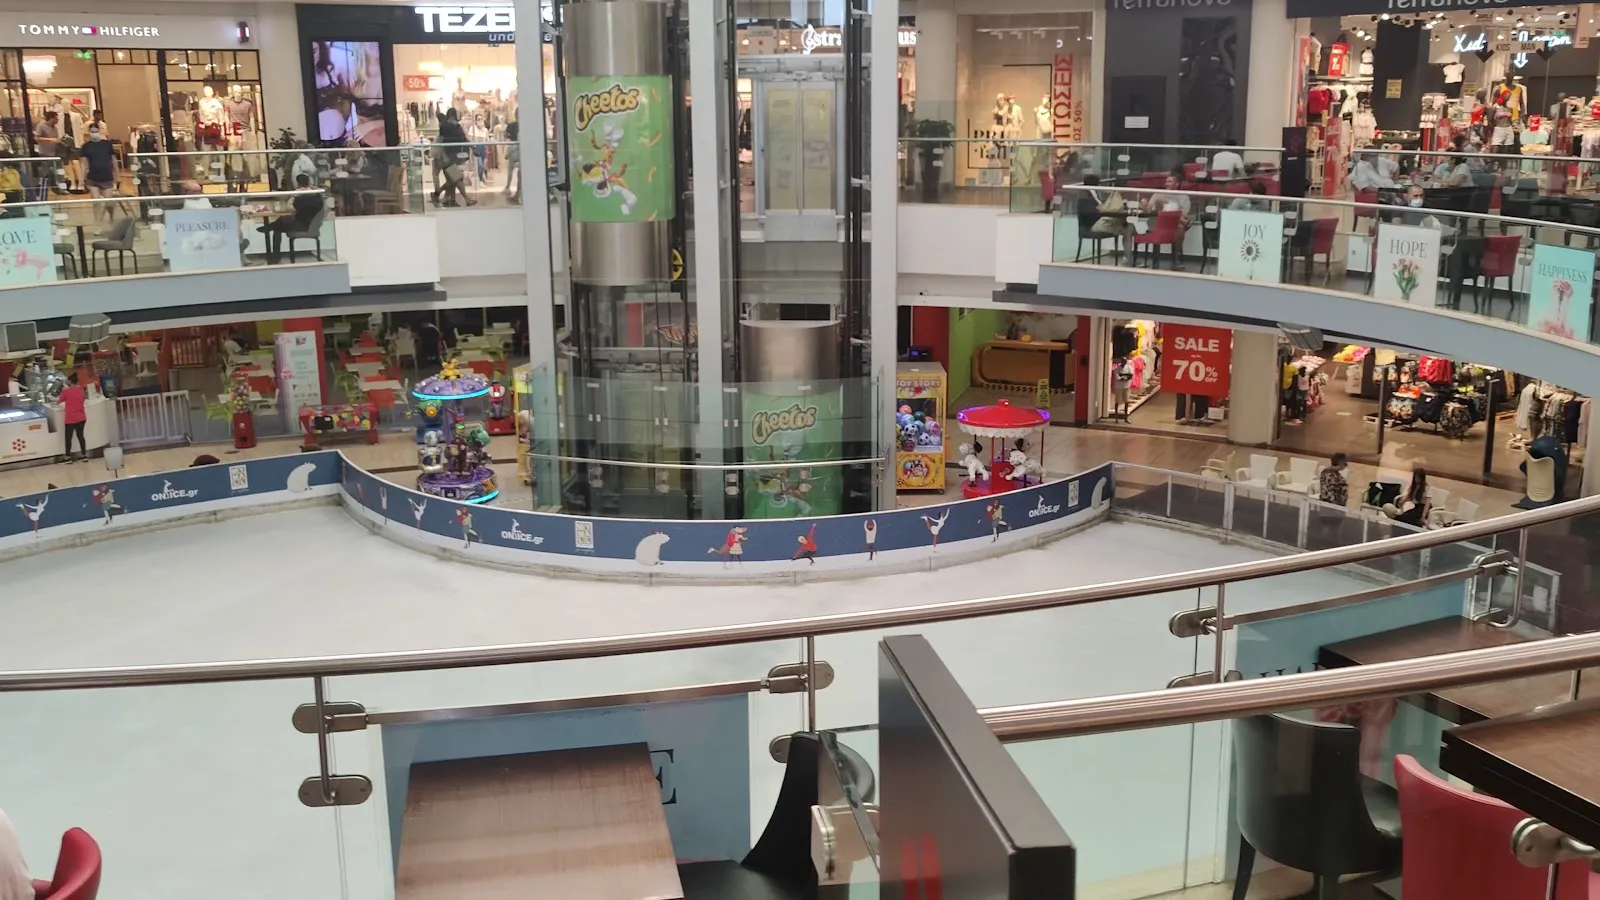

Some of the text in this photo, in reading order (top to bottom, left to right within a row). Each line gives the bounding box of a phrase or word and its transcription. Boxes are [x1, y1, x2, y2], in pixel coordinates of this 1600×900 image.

[414, 7, 554, 33] TEZE
[18, 24, 160, 37] TOMMY HILFIGER
[1496, 43, 1536, 51] KIDS MAN
[574, 84, 640, 131] Cheetos
[175, 221, 230, 233] PLEASURE
[1243, 223, 1267, 239] JOY
[1390, 239, 1428, 258] HOPE
[1538, 263, 1588, 284] HAPPINESS
[1174, 336, 1220, 353] SALE
[1172, 359, 1218, 382] 70%
[752, 403, 817, 445] Cheetos
